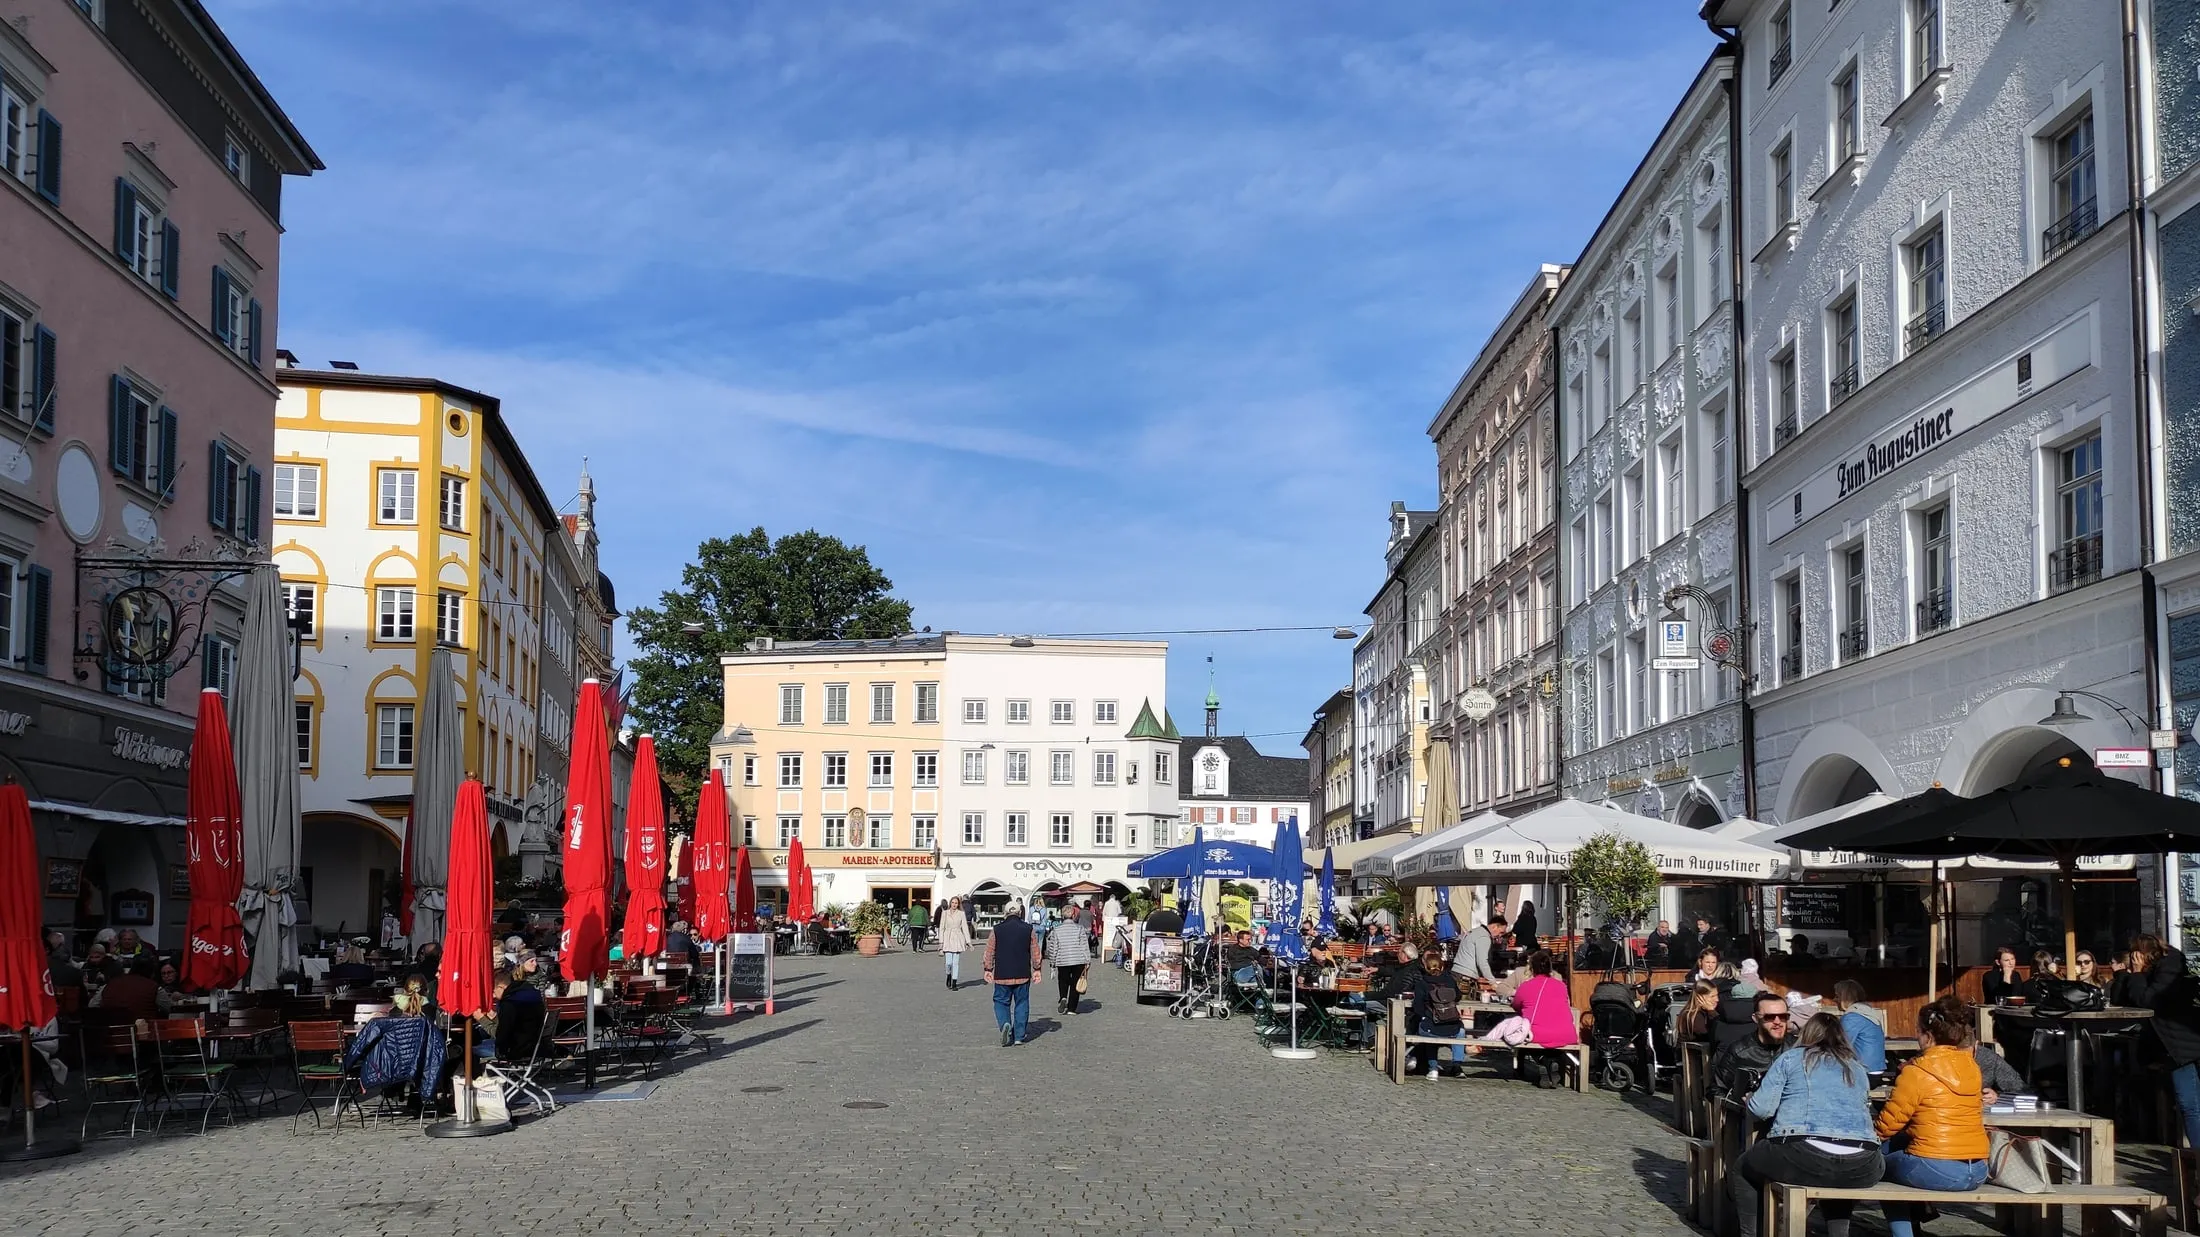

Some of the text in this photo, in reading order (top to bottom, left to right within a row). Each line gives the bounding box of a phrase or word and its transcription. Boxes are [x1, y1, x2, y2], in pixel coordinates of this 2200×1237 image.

[1837, 407, 1954, 499] Zum Augustiner
[842, 856, 933, 865] MARIEN-APOTHEKE
[1492, 850, 1572, 866] Zum August
[1655, 853, 1761, 873] Zum Augustiner
